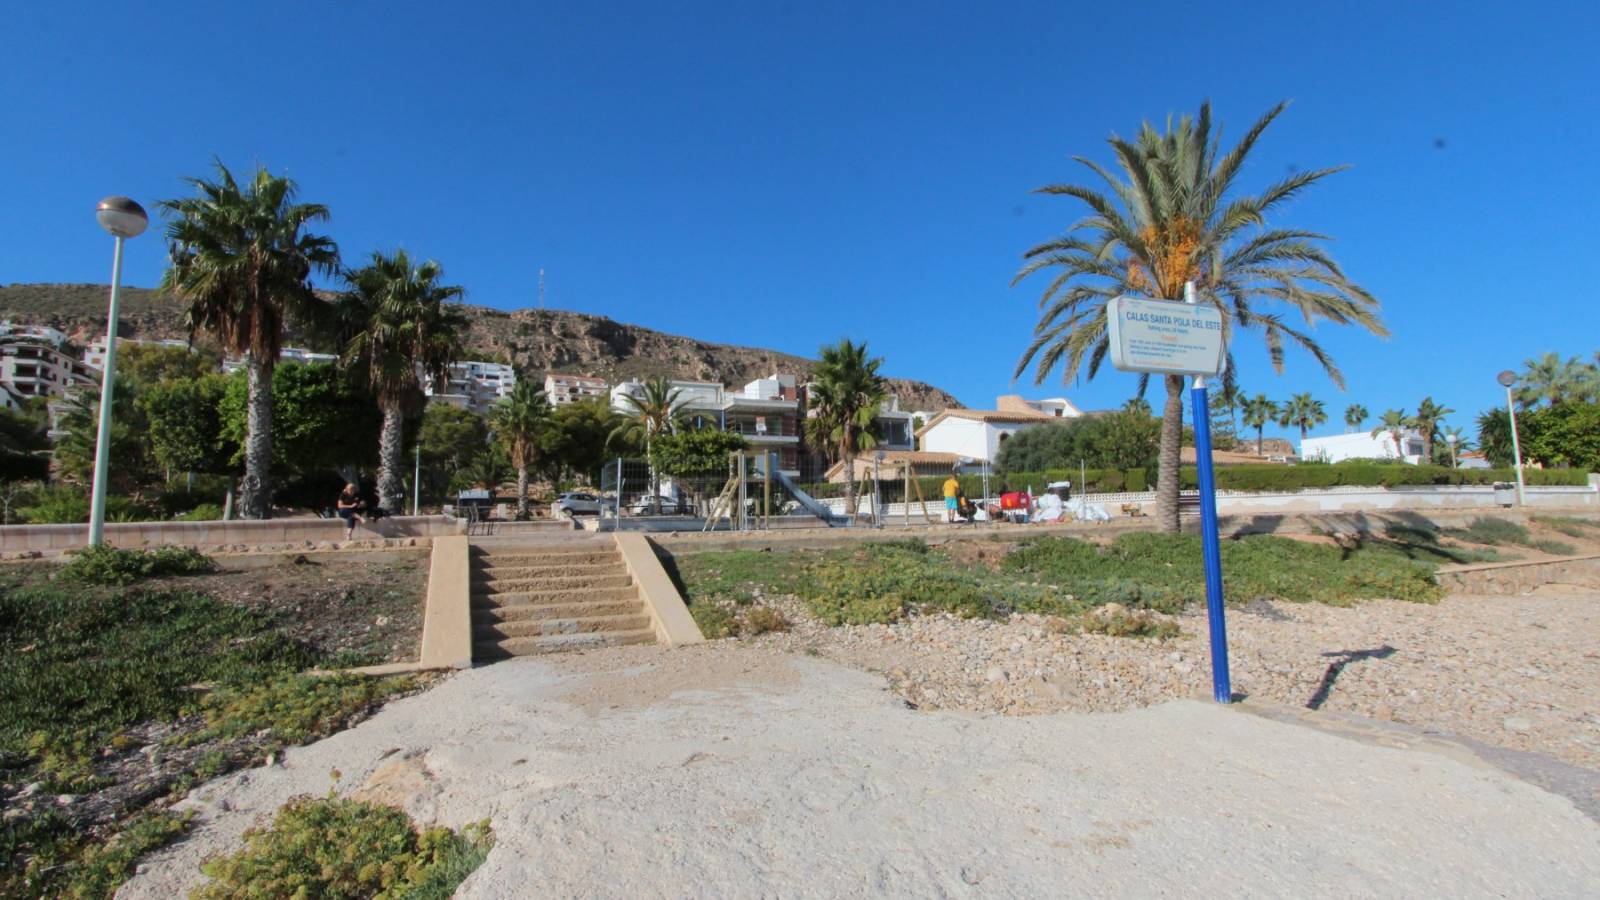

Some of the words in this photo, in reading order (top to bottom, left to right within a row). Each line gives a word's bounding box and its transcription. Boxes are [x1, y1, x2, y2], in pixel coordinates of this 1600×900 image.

[1126, 311, 1149, 322] CALAS
[1150, 314, 1173, 325] SANTA
[1173, 317, 1191, 328] POLA
[1192, 319, 1204, 329] DEL
[1205, 321, 1221, 331] ESTE
